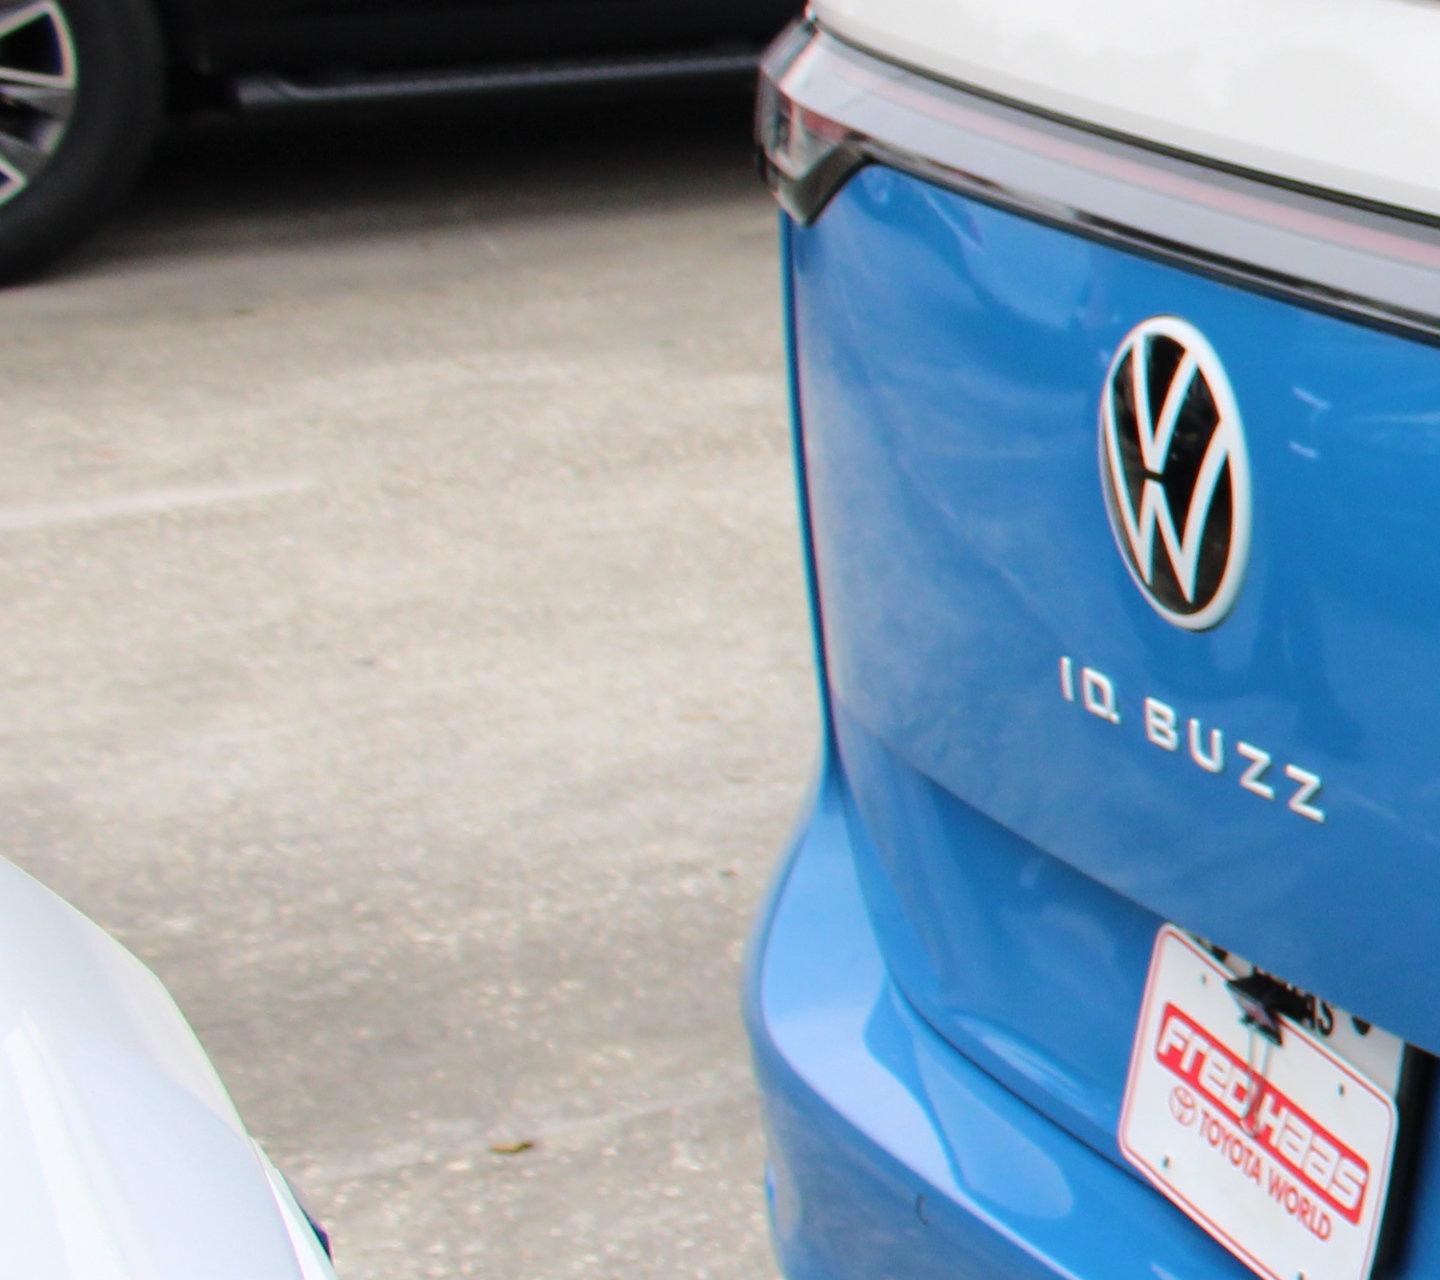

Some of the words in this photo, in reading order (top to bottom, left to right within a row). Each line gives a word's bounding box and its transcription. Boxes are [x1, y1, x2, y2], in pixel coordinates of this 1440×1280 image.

[1144, 696, 1327, 824] BUZZ
[1200, 1109, 1263, 1188] TOYOTA
[1268, 1164, 1333, 1241] WORLD
